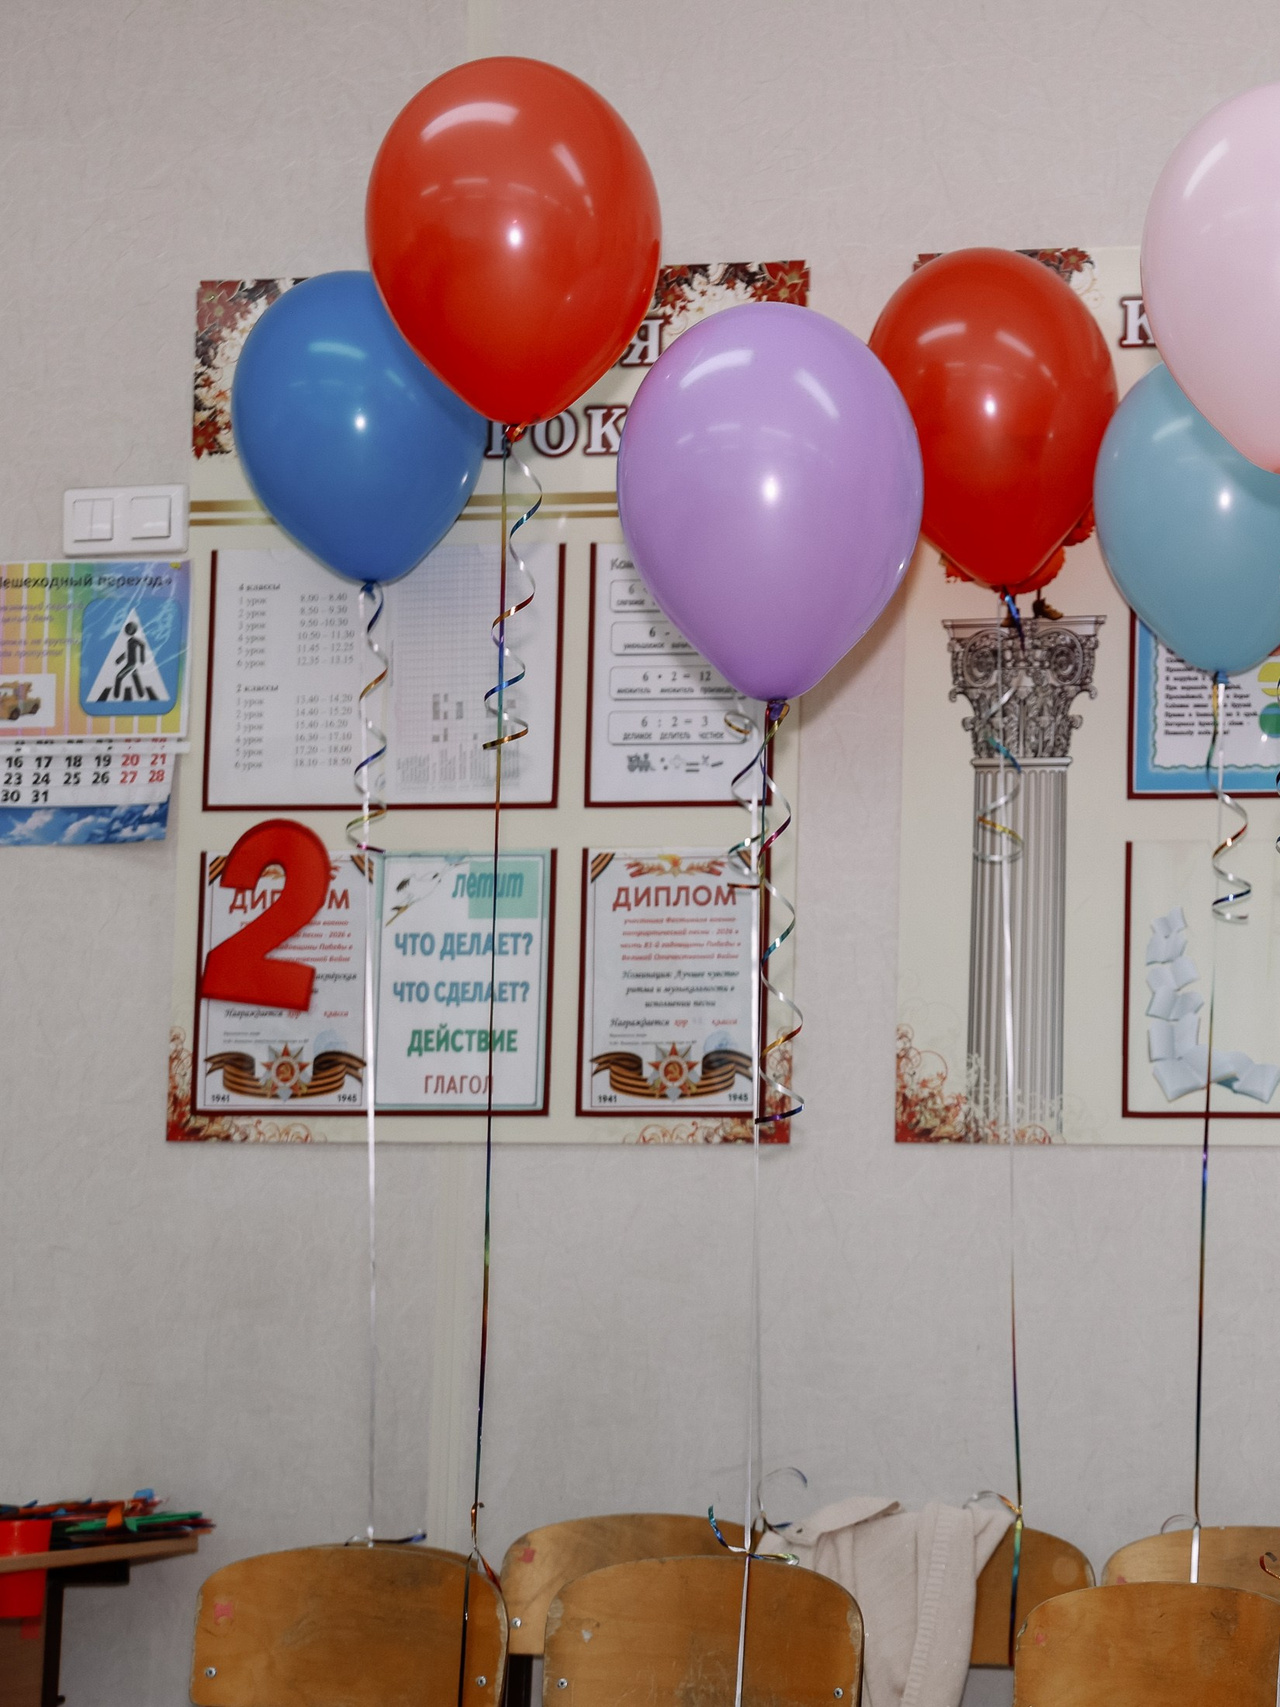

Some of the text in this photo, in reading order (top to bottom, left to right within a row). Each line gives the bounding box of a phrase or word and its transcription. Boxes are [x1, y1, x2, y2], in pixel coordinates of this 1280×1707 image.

[246, 583, 281, 591] классы
[247, 597, 267, 606] урок
[246, 610, 266, 619] урок
[246, 622, 266, 631] урок
[649, 626, 656, 637] 6
[245, 634, 266, 643] урок
[245, 647, 265, 656] урок
[245, 660, 265, 668] урок
[643, 671, 712, 682] 6 2 12
[244, 698, 264, 707] урок
[244, 710, 263, 719] урок
[641, 715, 709, 727] 6 2 3
[243, 723, 263, 731] урок
[243, 736, 263, 745] урок
[243, 748, 262, 757] урок
[6, 754, 167, 769] 16 17 18 19 20 21
[242, 761, 262, 770] урок
[4, 770, 165, 786] 23 24 25 26 27 28
[1, 790, 49, 803] 30 31
[452, 871, 525, 899] летит
[612, 884, 737, 911] ДИПЛОМ
[394, 931, 534, 961] ЧТО ДЕЛАЕТ?
[393, 981, 530, 1008] ЧТО СДЕЛАЕТ?
[406, 1023, 518, 1058] ДЕЙСТВИЕ
[424, 1075, 495, 1095] ГЛАГОЛ
[211, 1094, 357, 1103] 1941 1945
[598, 1093, 749, 1104] 1941 1945
